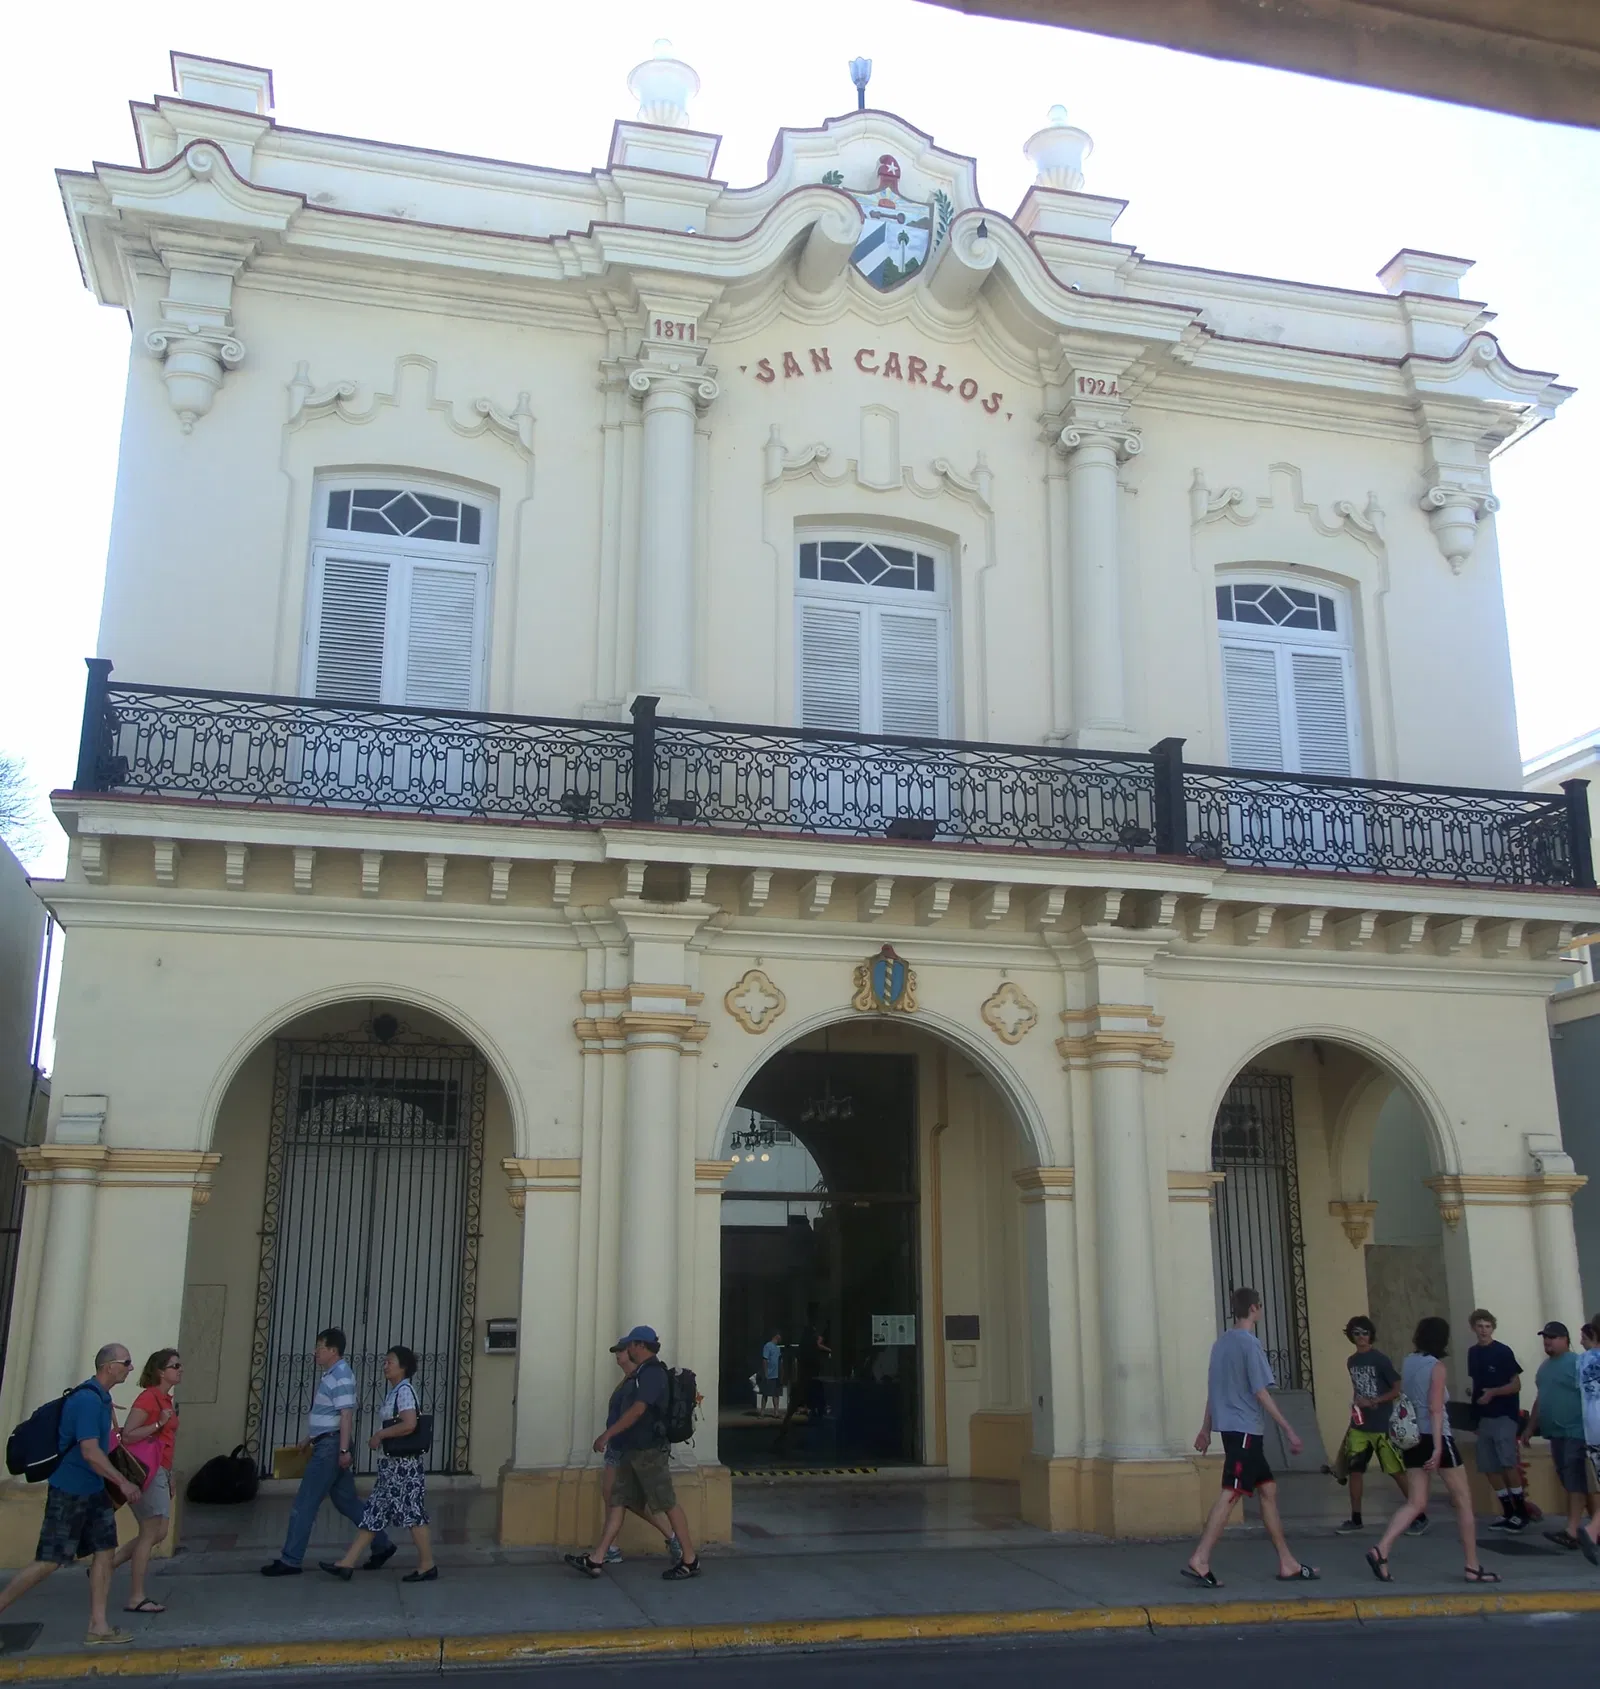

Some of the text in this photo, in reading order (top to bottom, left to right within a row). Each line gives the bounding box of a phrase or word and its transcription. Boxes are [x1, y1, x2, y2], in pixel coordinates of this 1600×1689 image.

[654, 319, 695, 342] 1871
[755, 347, 833, 384] SAN
[1078, 376, 1120, 396] 1924
